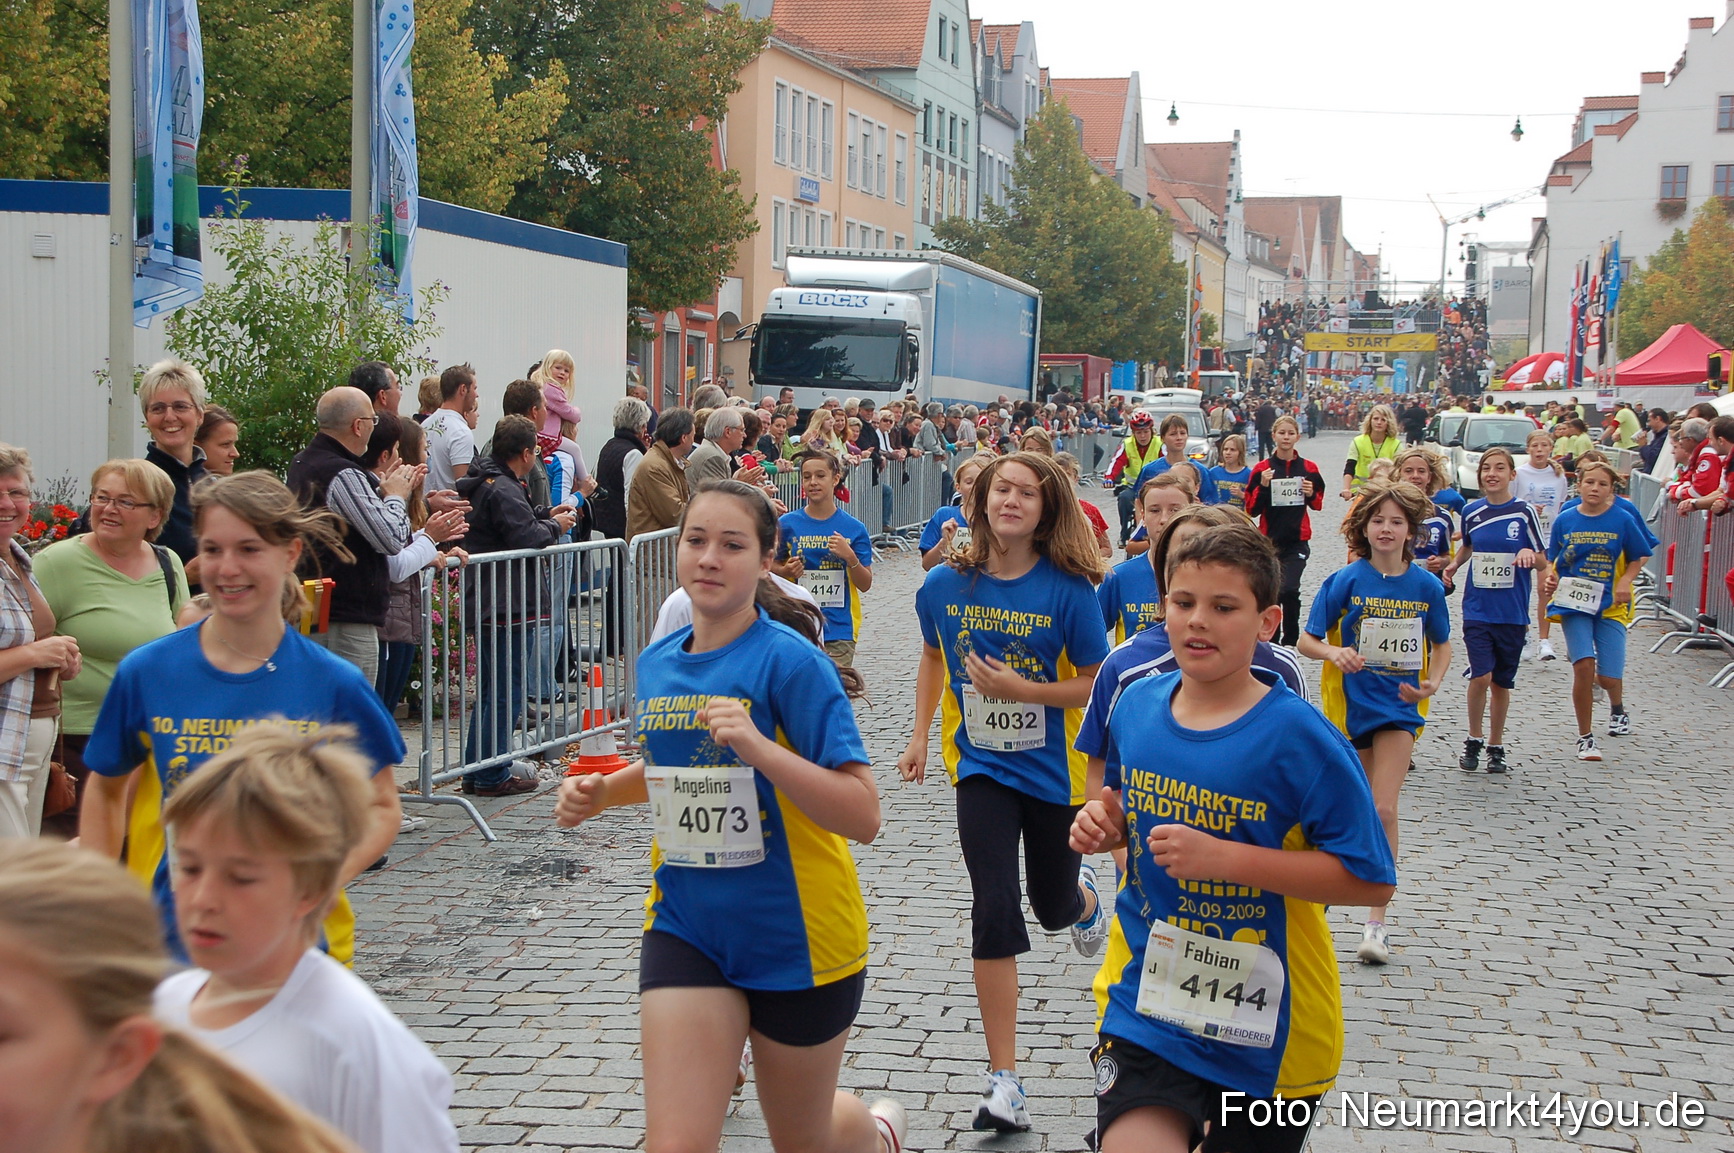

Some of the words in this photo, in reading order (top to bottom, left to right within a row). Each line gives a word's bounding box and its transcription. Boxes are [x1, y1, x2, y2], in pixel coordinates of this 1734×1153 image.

[799, 292, 869, 308] BOCK
[1346, 336, 1392, 348] START
[1281, 488, 1303, 497] 4045
[800, 535, 851, 545] NEUMAR
[810, 572, 830, 581] Selina
[1482, 566, 1511, 577] 4126
[811, 584, 841, 595] 4147
[1568, 590, 1596, 603] 4031
[1125, 603, 1139, 613] 10.
[1350, 596, 1364, 606] 10.
[1365, 596, 1430, 613] NEUMARKTER
[1362, 606, 1418, 619] STADTLAUF
[945, 604, 962, 617] 10.
[964, 604, 1052, 629] NEUMARKTER
[961, 617, 1033, 638] STADTLAUF
[1378, 638, 1418, 653] 4163
[967, 708, 973, 718] J
[985, 711, 1038, 730] 4032
[152, 717, 178, 735] 10.
[638, 713, 710, 731] STADTLA
[673, 775, 732, 798] Angelina
[1131, 768, 1268, 822] NEUMARKTER
[1127, 789, 1238, 833] STADTLAUF
[679, 806, 750, 834] 4073
[1178, 896, 1267, 920] 20.09.2009
[1184, 940, 1241, 971] Fabian
[1148, 962, 1158, 975] J
[1179, 974, 1268, 1012] 4144
[1219, 1025, 1272, 1043] PFLEIDERER
